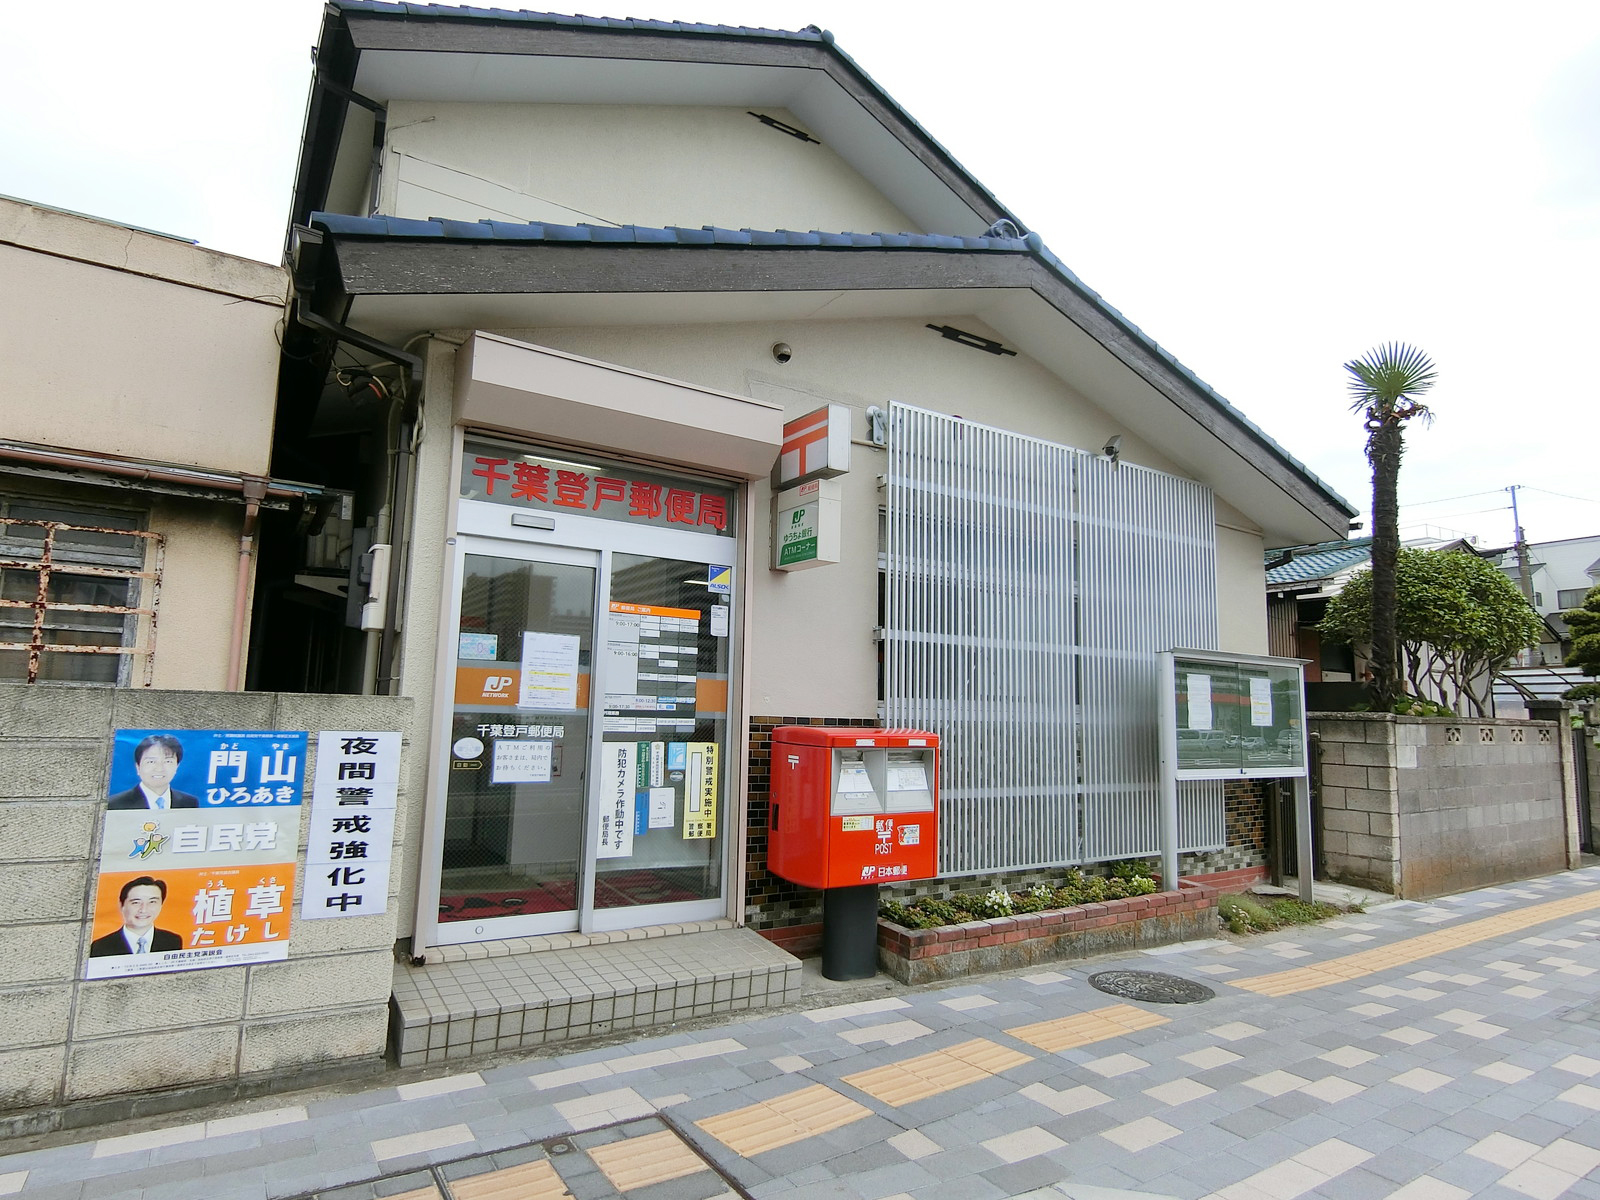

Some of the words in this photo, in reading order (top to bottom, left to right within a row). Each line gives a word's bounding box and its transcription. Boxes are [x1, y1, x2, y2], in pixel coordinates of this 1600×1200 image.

[471, 457, 728, 531] 千葉登戸郵便局
[783, 526, 813, 543] ゆうちょ銀行
[784, 542, 816, 556] ATMコーナー
[483, 676, 513, 692] JP
[476, 723, 565, 738] 千葉登戸郵便局
[207, 749, 297, 785] 門山
[704, 746, 714, 818] 特別警戒実施中
[206, 785, 296, 806] ひろあき
[614, 748, 627, 850] 防犯カメラ作動中です
[326, 737, 379, 912] 夜間警戒強化中
[601, 815, 610, 846] 郵便局長
[876, 818, 894, 832] 郵便
[171, 821, 278, 854] 自民党
[875, 842, 892, 854] POST
[878, 865, 908, 876] 日本郵便
[207, 879, 226, 888] うえ
[192, 884, 286, 925] 植草
[191, 921, 280, 946] たけし
[163, 949, 224, 961] 自由民主党演説会
